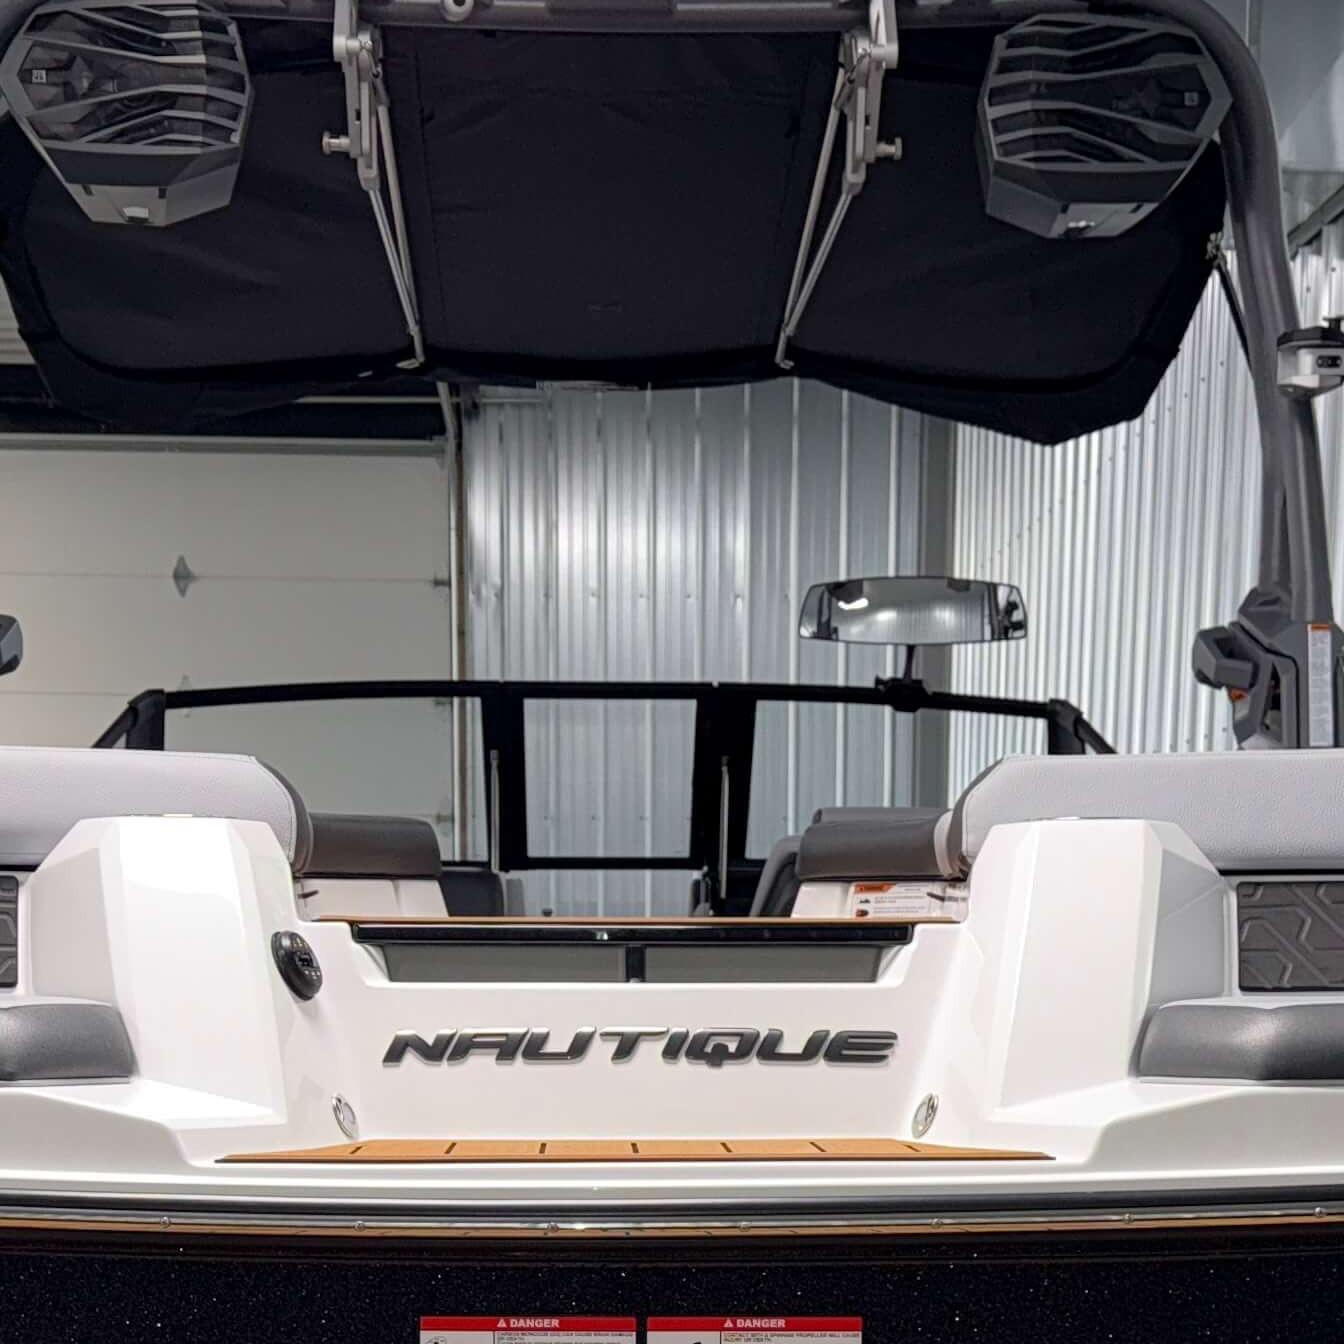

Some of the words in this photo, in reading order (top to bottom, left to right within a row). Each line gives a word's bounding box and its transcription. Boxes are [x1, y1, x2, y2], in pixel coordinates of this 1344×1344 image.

[382, 1027, 898, 1067] NAUTIQUE
[509, 1318, 560, 1329] DANGER
[736, 1318, 787, 1329] DANGER
